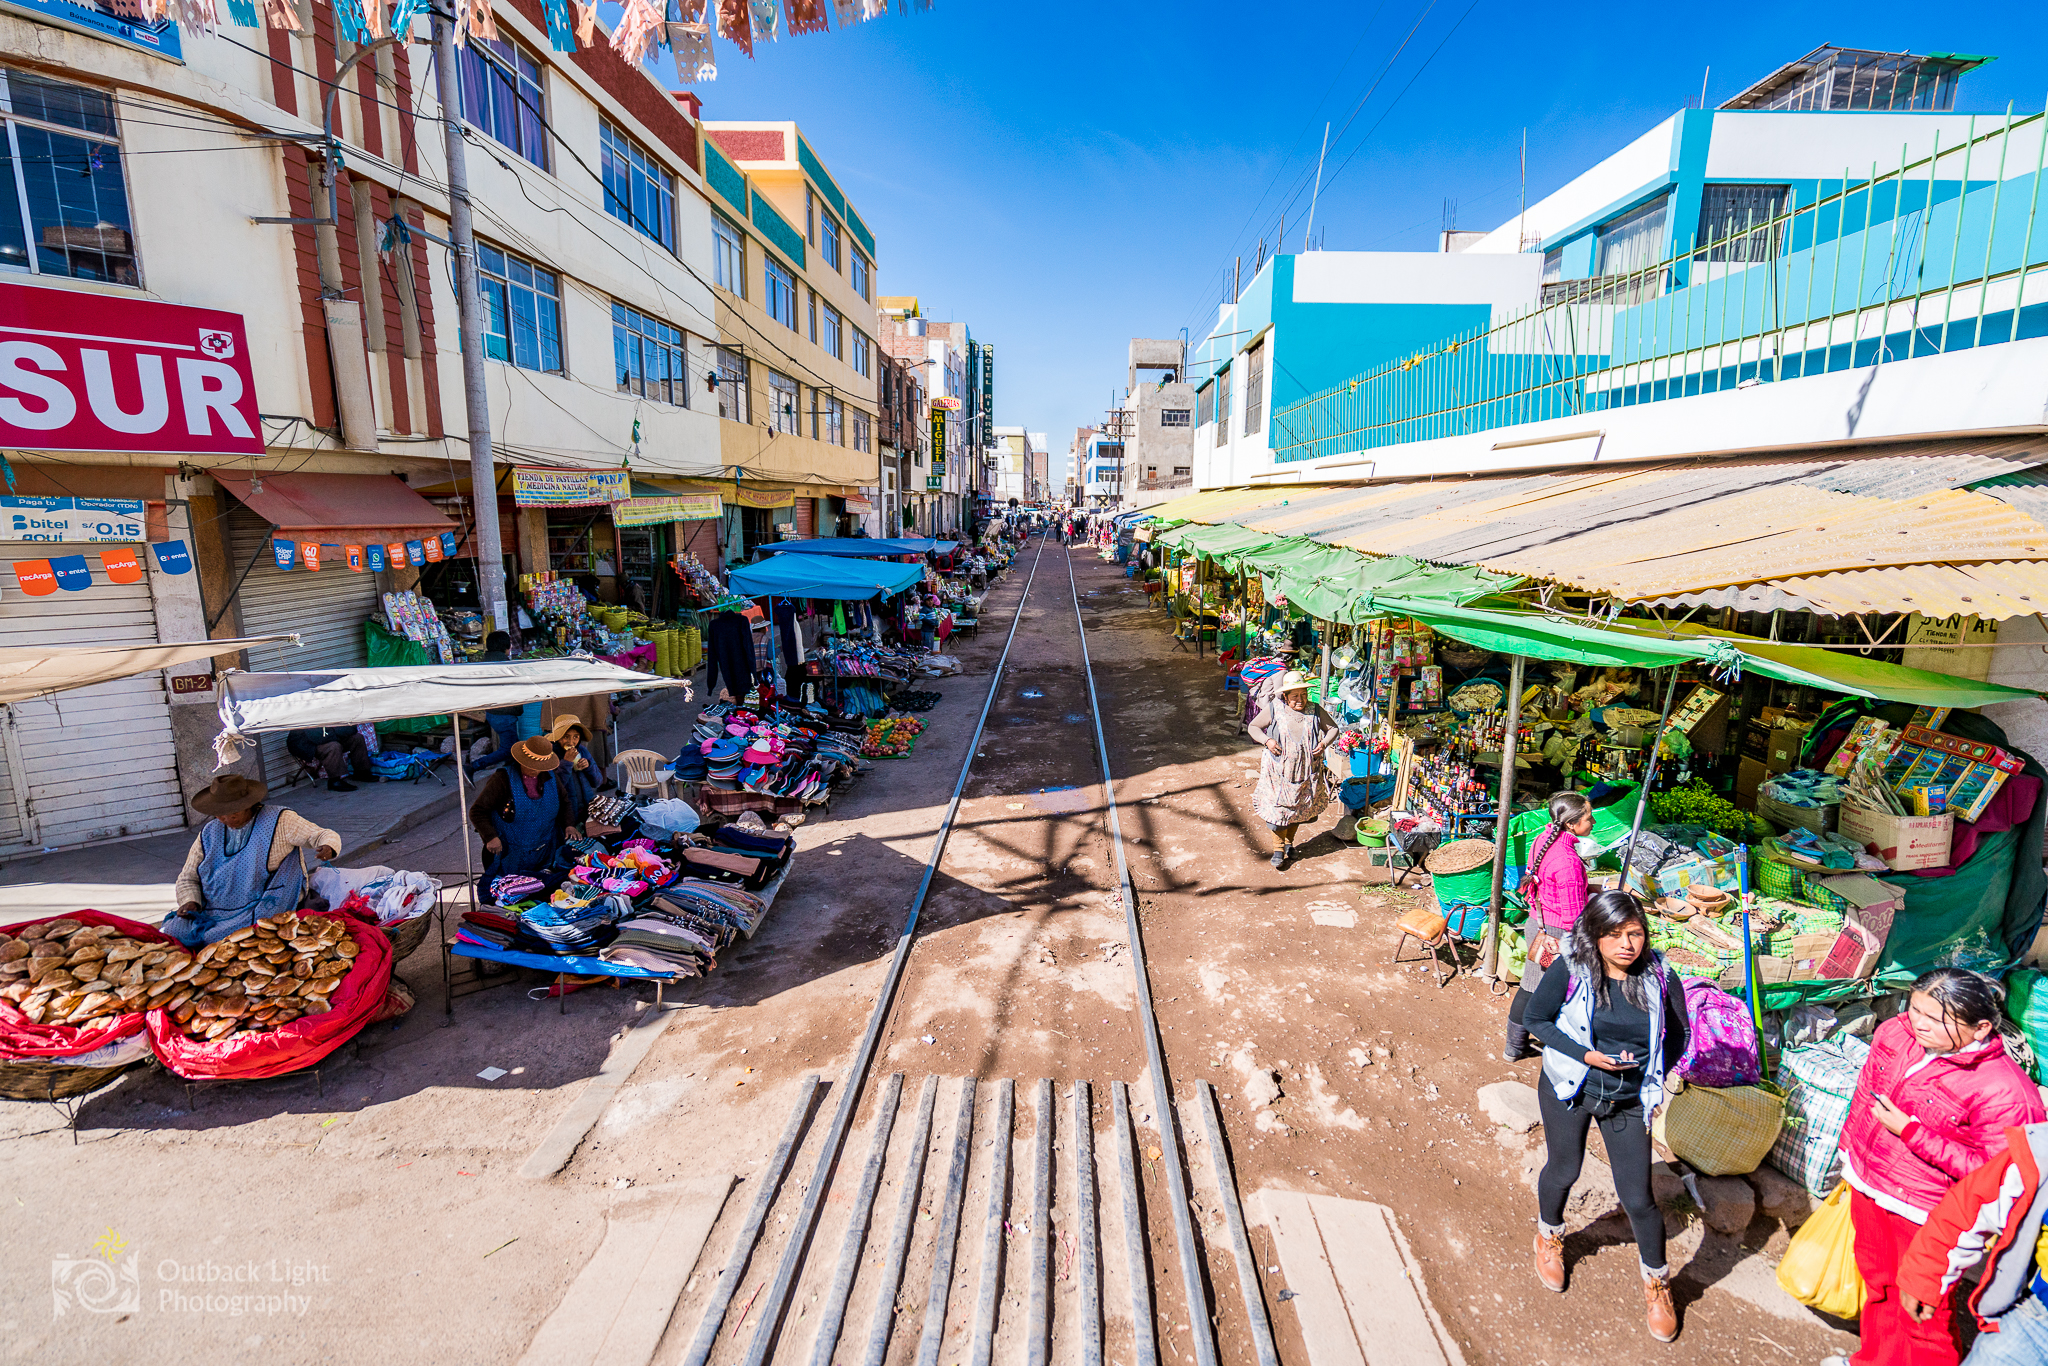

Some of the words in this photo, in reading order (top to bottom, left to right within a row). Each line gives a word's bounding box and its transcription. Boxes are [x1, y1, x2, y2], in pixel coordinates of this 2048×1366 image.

[70, 11, 104, 28] Búscanos
[0, 341, 256, 438] SUR
[932, 398, 960, 408] GALERIAS
[984, 394, 992, 440] RIVEROS
[933, 416, 944, 462] MIGUEL
[516, 472, 544, 482] TIENDA
[546, 474, 554, 482] DE
[519, 481, 524, 489] Y
[527, 481, 560, 490] MEDICINA
[30, 519, 68, 530] bitel
[426, 540, 436, 550] 60
[171, 552, 187, 560] entel
[304, 546, 317, 557] 60
[106, 561, 137, 570] recArga
[20, 573, 52, 581] recArga
[176, 676, 207, 690] BM-2
